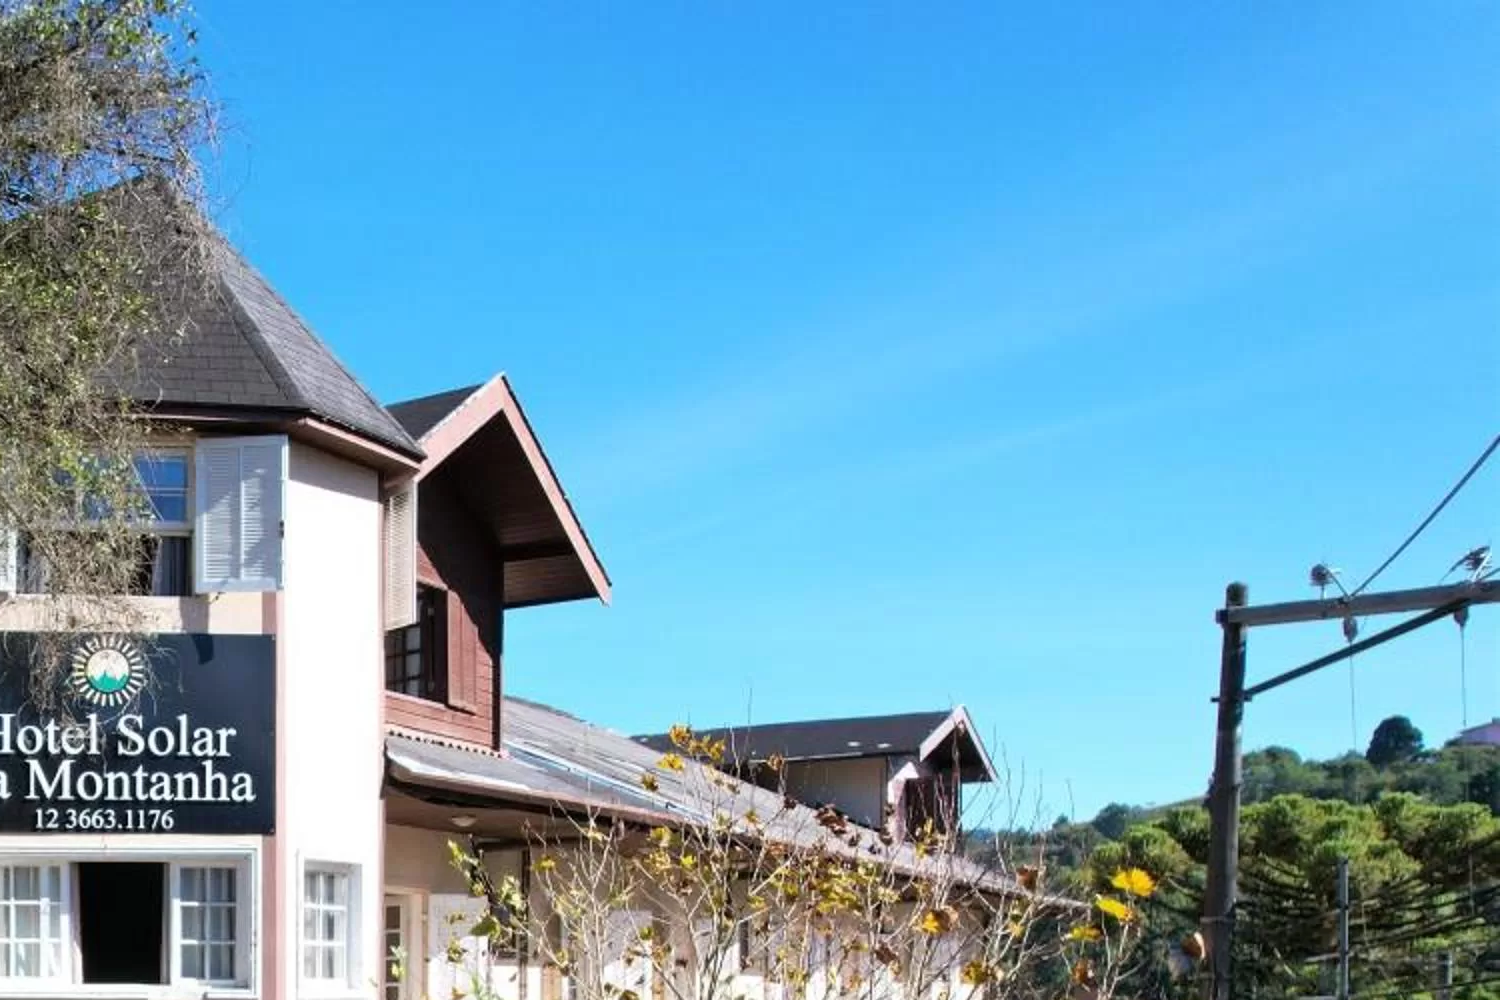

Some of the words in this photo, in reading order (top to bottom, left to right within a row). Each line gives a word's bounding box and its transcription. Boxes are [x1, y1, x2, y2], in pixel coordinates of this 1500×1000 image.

[117, 714, 237, 757] Solar
[25, 759, 257, 802] Montanha
[35, 808, 59, 829] 12
[65, 808, 175, 830] 3663.1176
